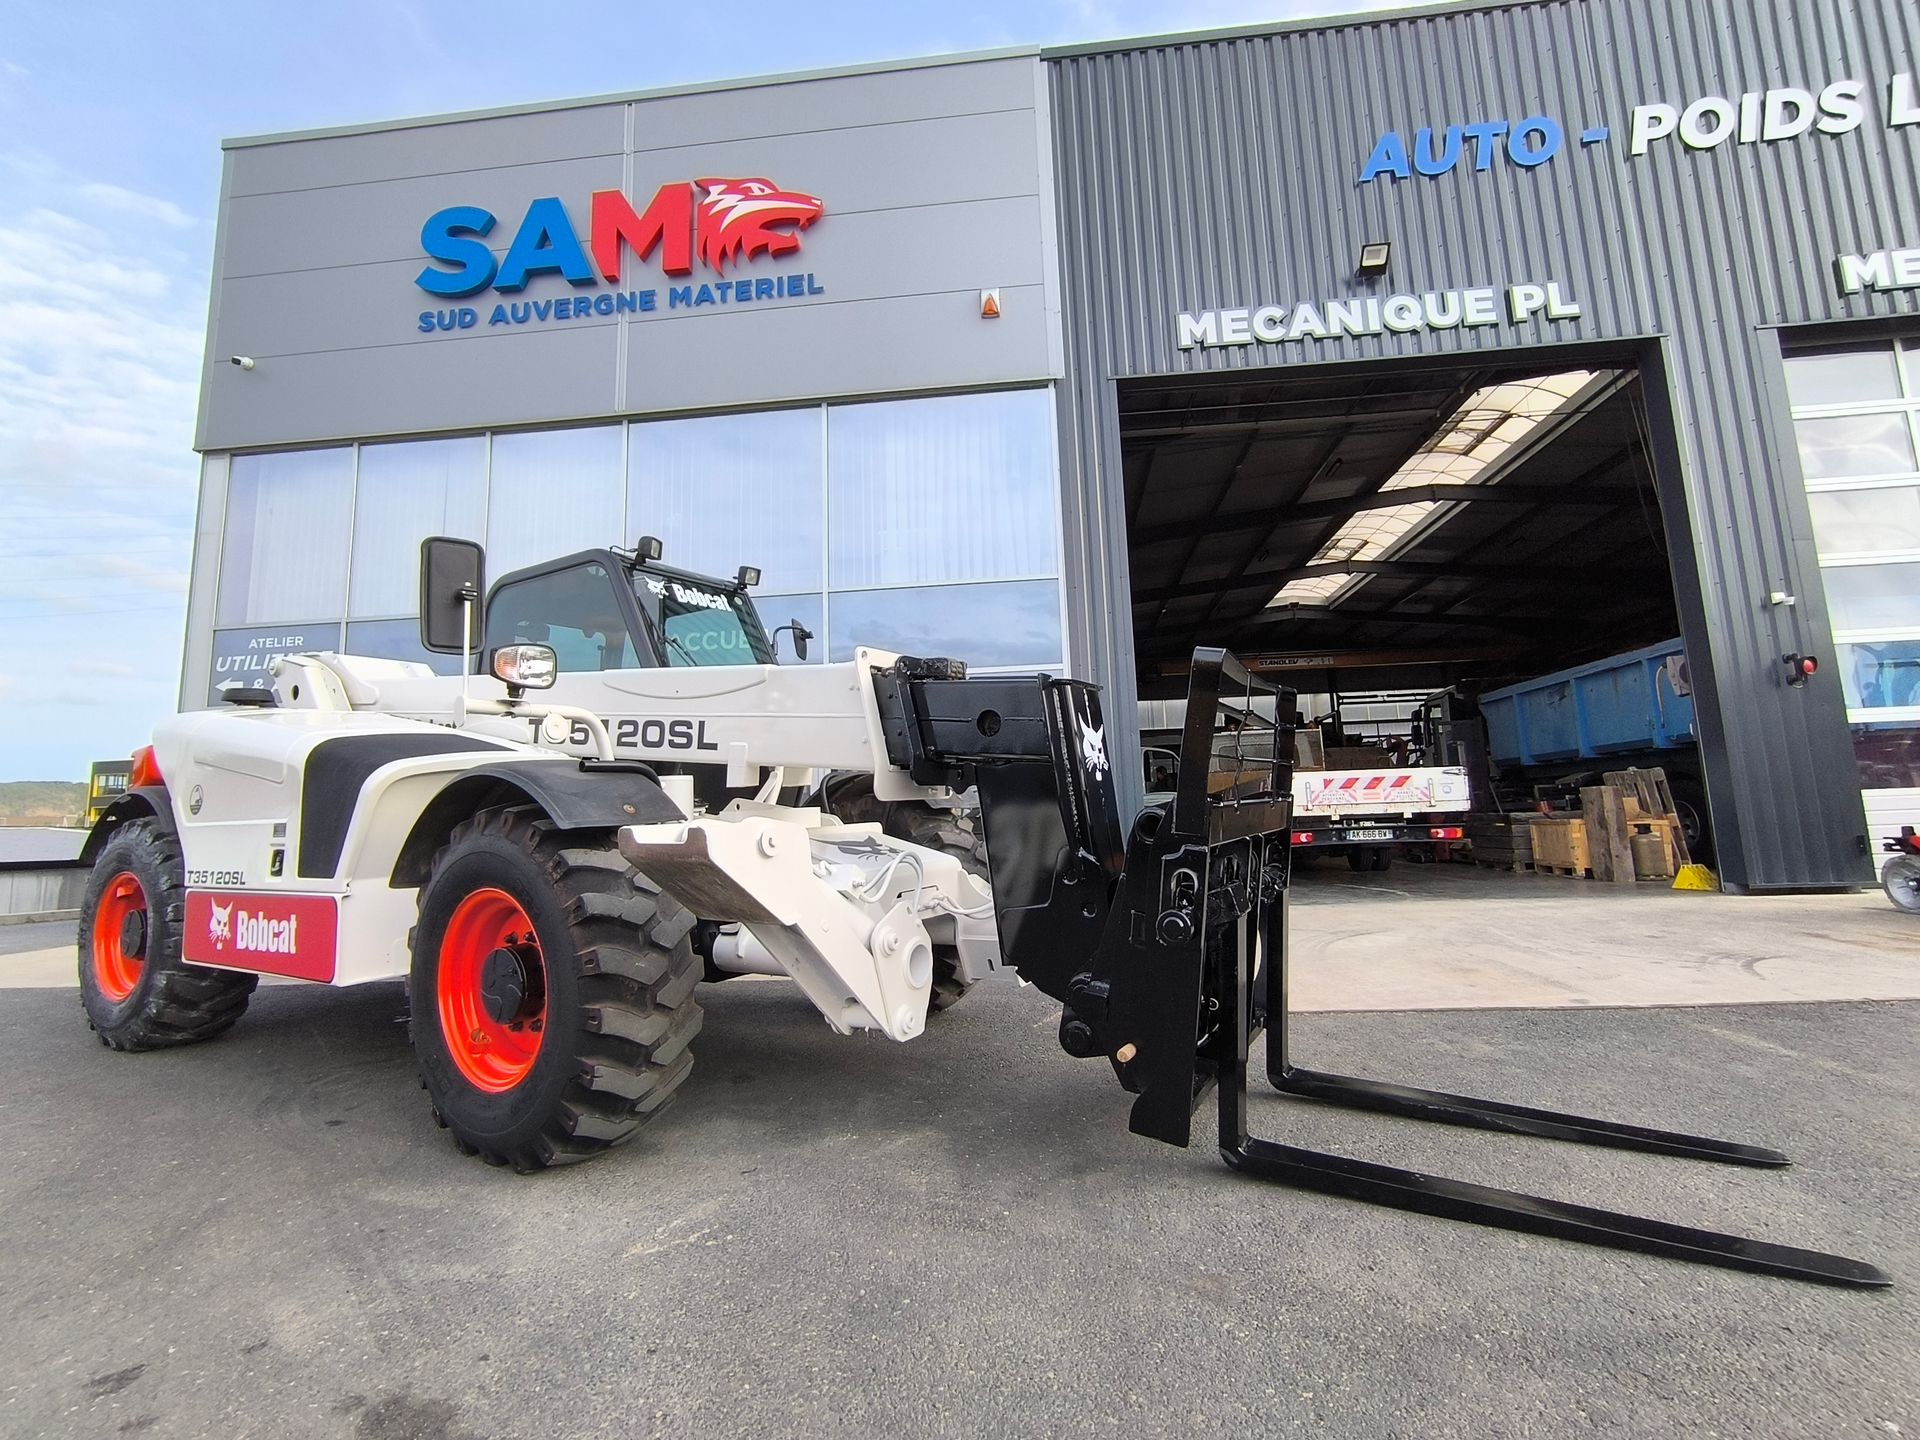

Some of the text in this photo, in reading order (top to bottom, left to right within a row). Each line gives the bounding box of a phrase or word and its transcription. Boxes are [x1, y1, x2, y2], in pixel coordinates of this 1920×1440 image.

[1358, 116, 1563, 183] AUTO
[1629, 79, 1866, 156] POIDS
[414, 182, 695, 298] SAM
[1837, 249, 1920, 294] ME
[417, 273, 825, 332] SUD AUVERGNE MATERIEL
[1177, 281, 1581, 351] MECANIQUE PL
[671, 583, 733, 612] Bobcat
[248, 636, 304, 649] ATELIER
[528, 718, 718, 751] T520SL
[187, 870, 246, 886] T35120SL
[236, 910, 297, 955] Bobcat
